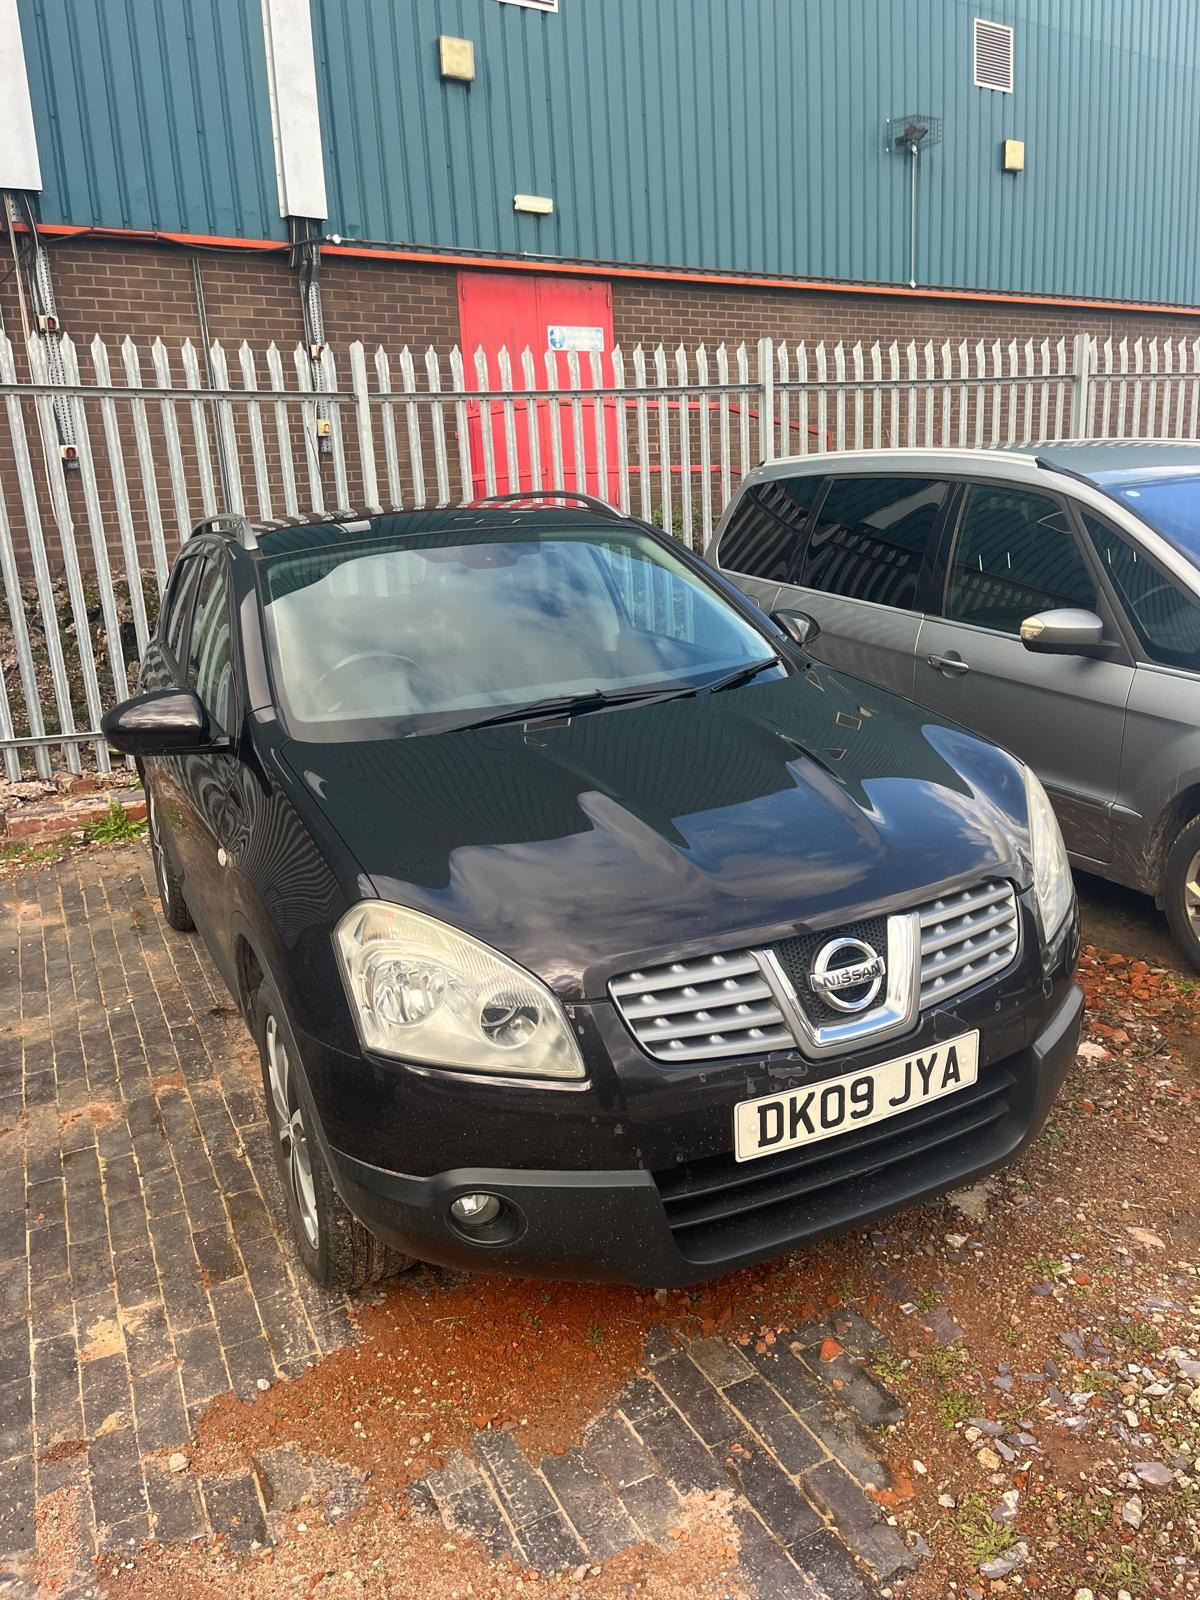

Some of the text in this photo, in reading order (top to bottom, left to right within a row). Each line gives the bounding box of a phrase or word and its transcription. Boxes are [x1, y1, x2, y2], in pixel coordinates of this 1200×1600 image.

[823, 960, 880, 988] NISSAN
[758, 1046, 960, 1147] DK09 JYA
